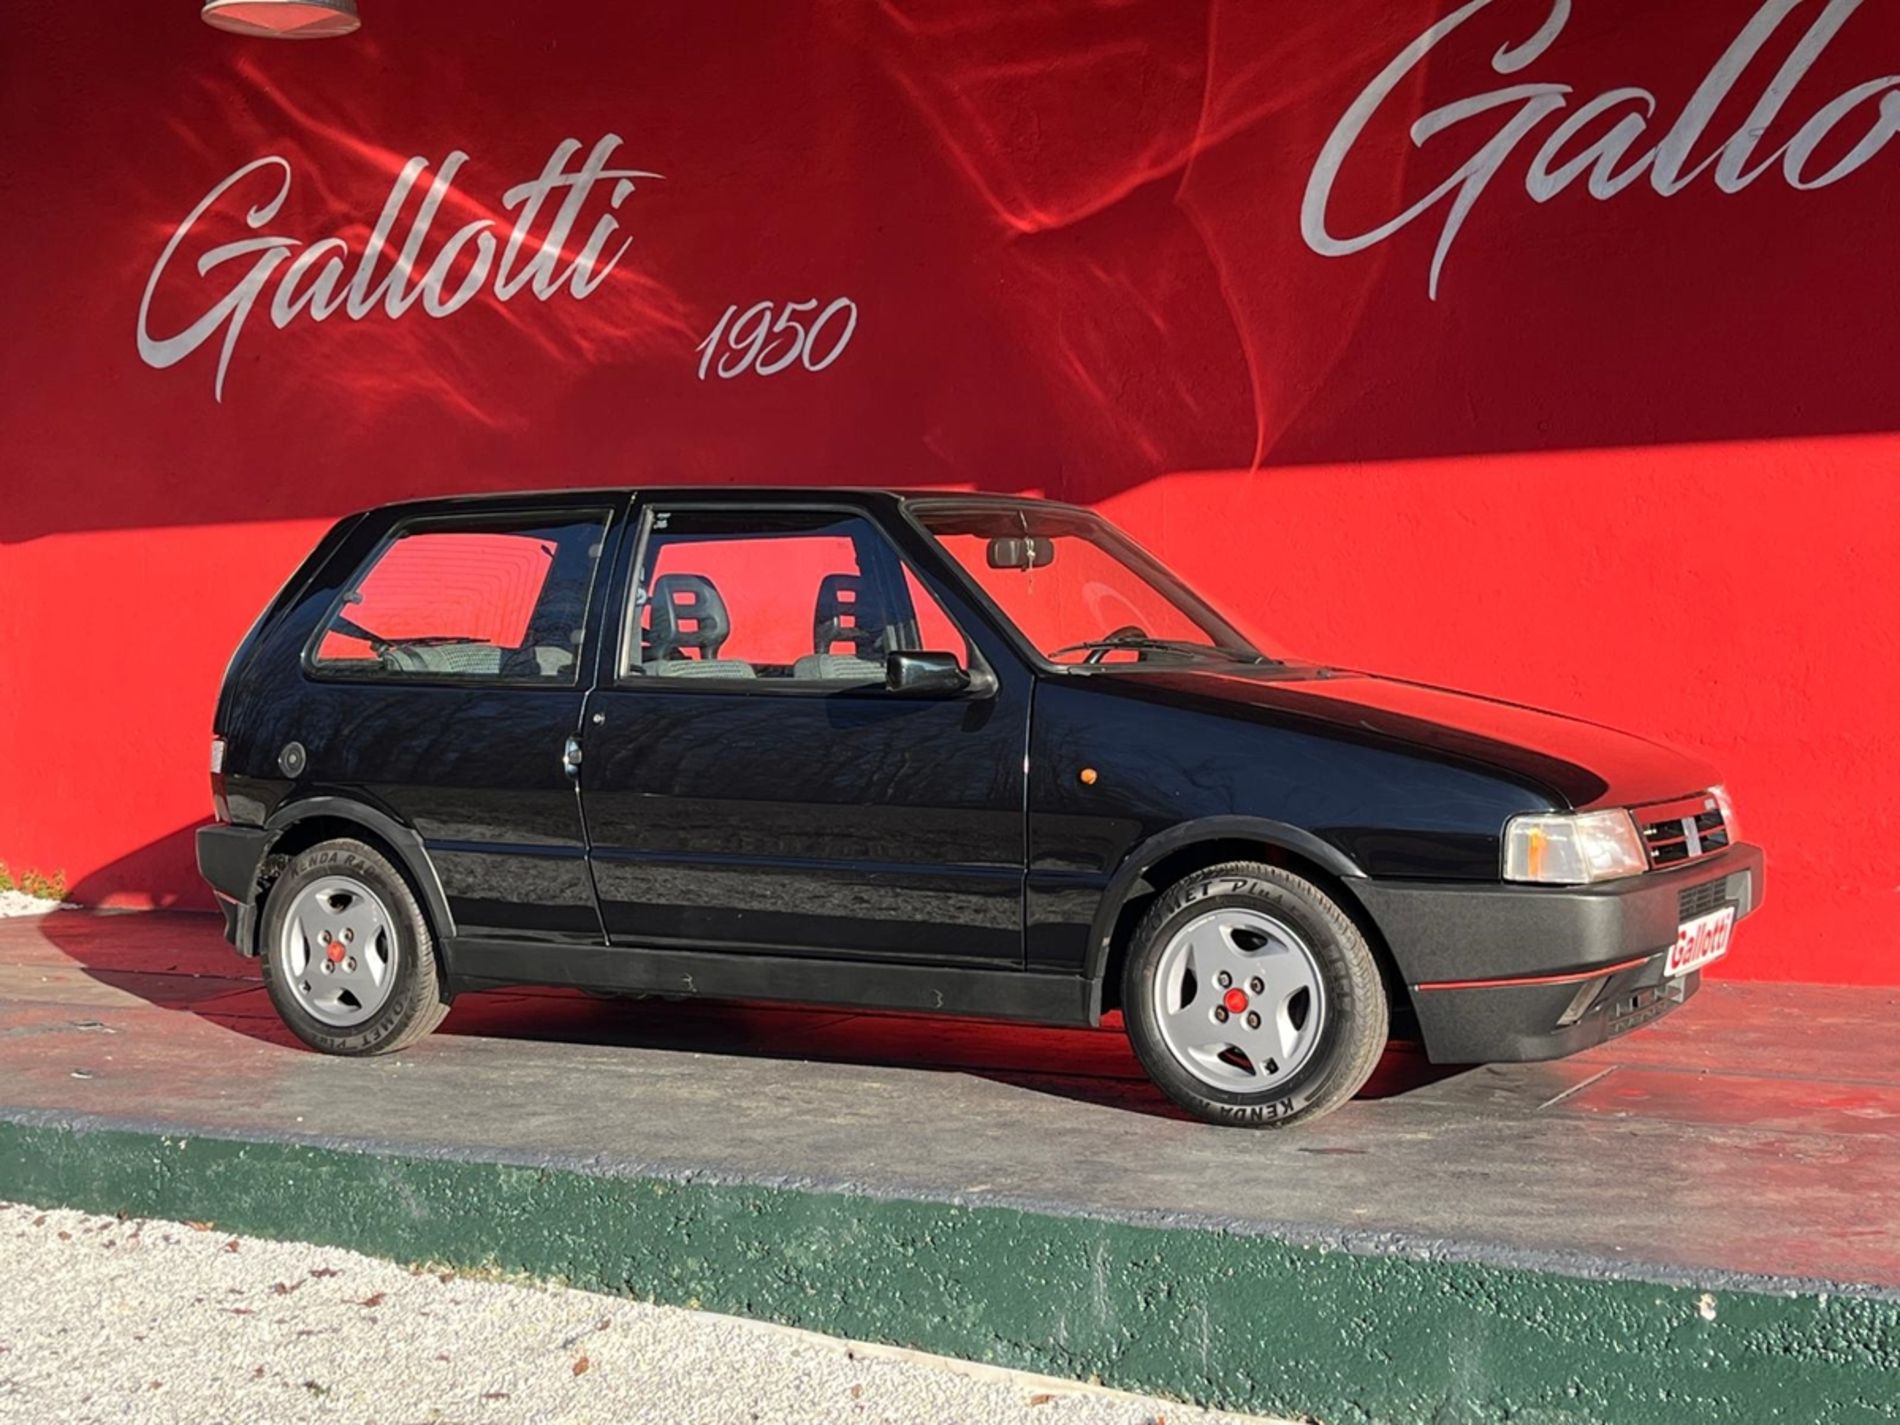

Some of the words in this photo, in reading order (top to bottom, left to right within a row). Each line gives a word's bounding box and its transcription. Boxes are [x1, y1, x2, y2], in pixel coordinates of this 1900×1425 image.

[137, 134, 662, 402] Gallotti
[697, 298, 857, 378] 1950
[291, 851, 338, 879] KENDA
[1671, 912, 1731, 970] Gallotti
[1220, 1096, 1294, 1122] KENDA
